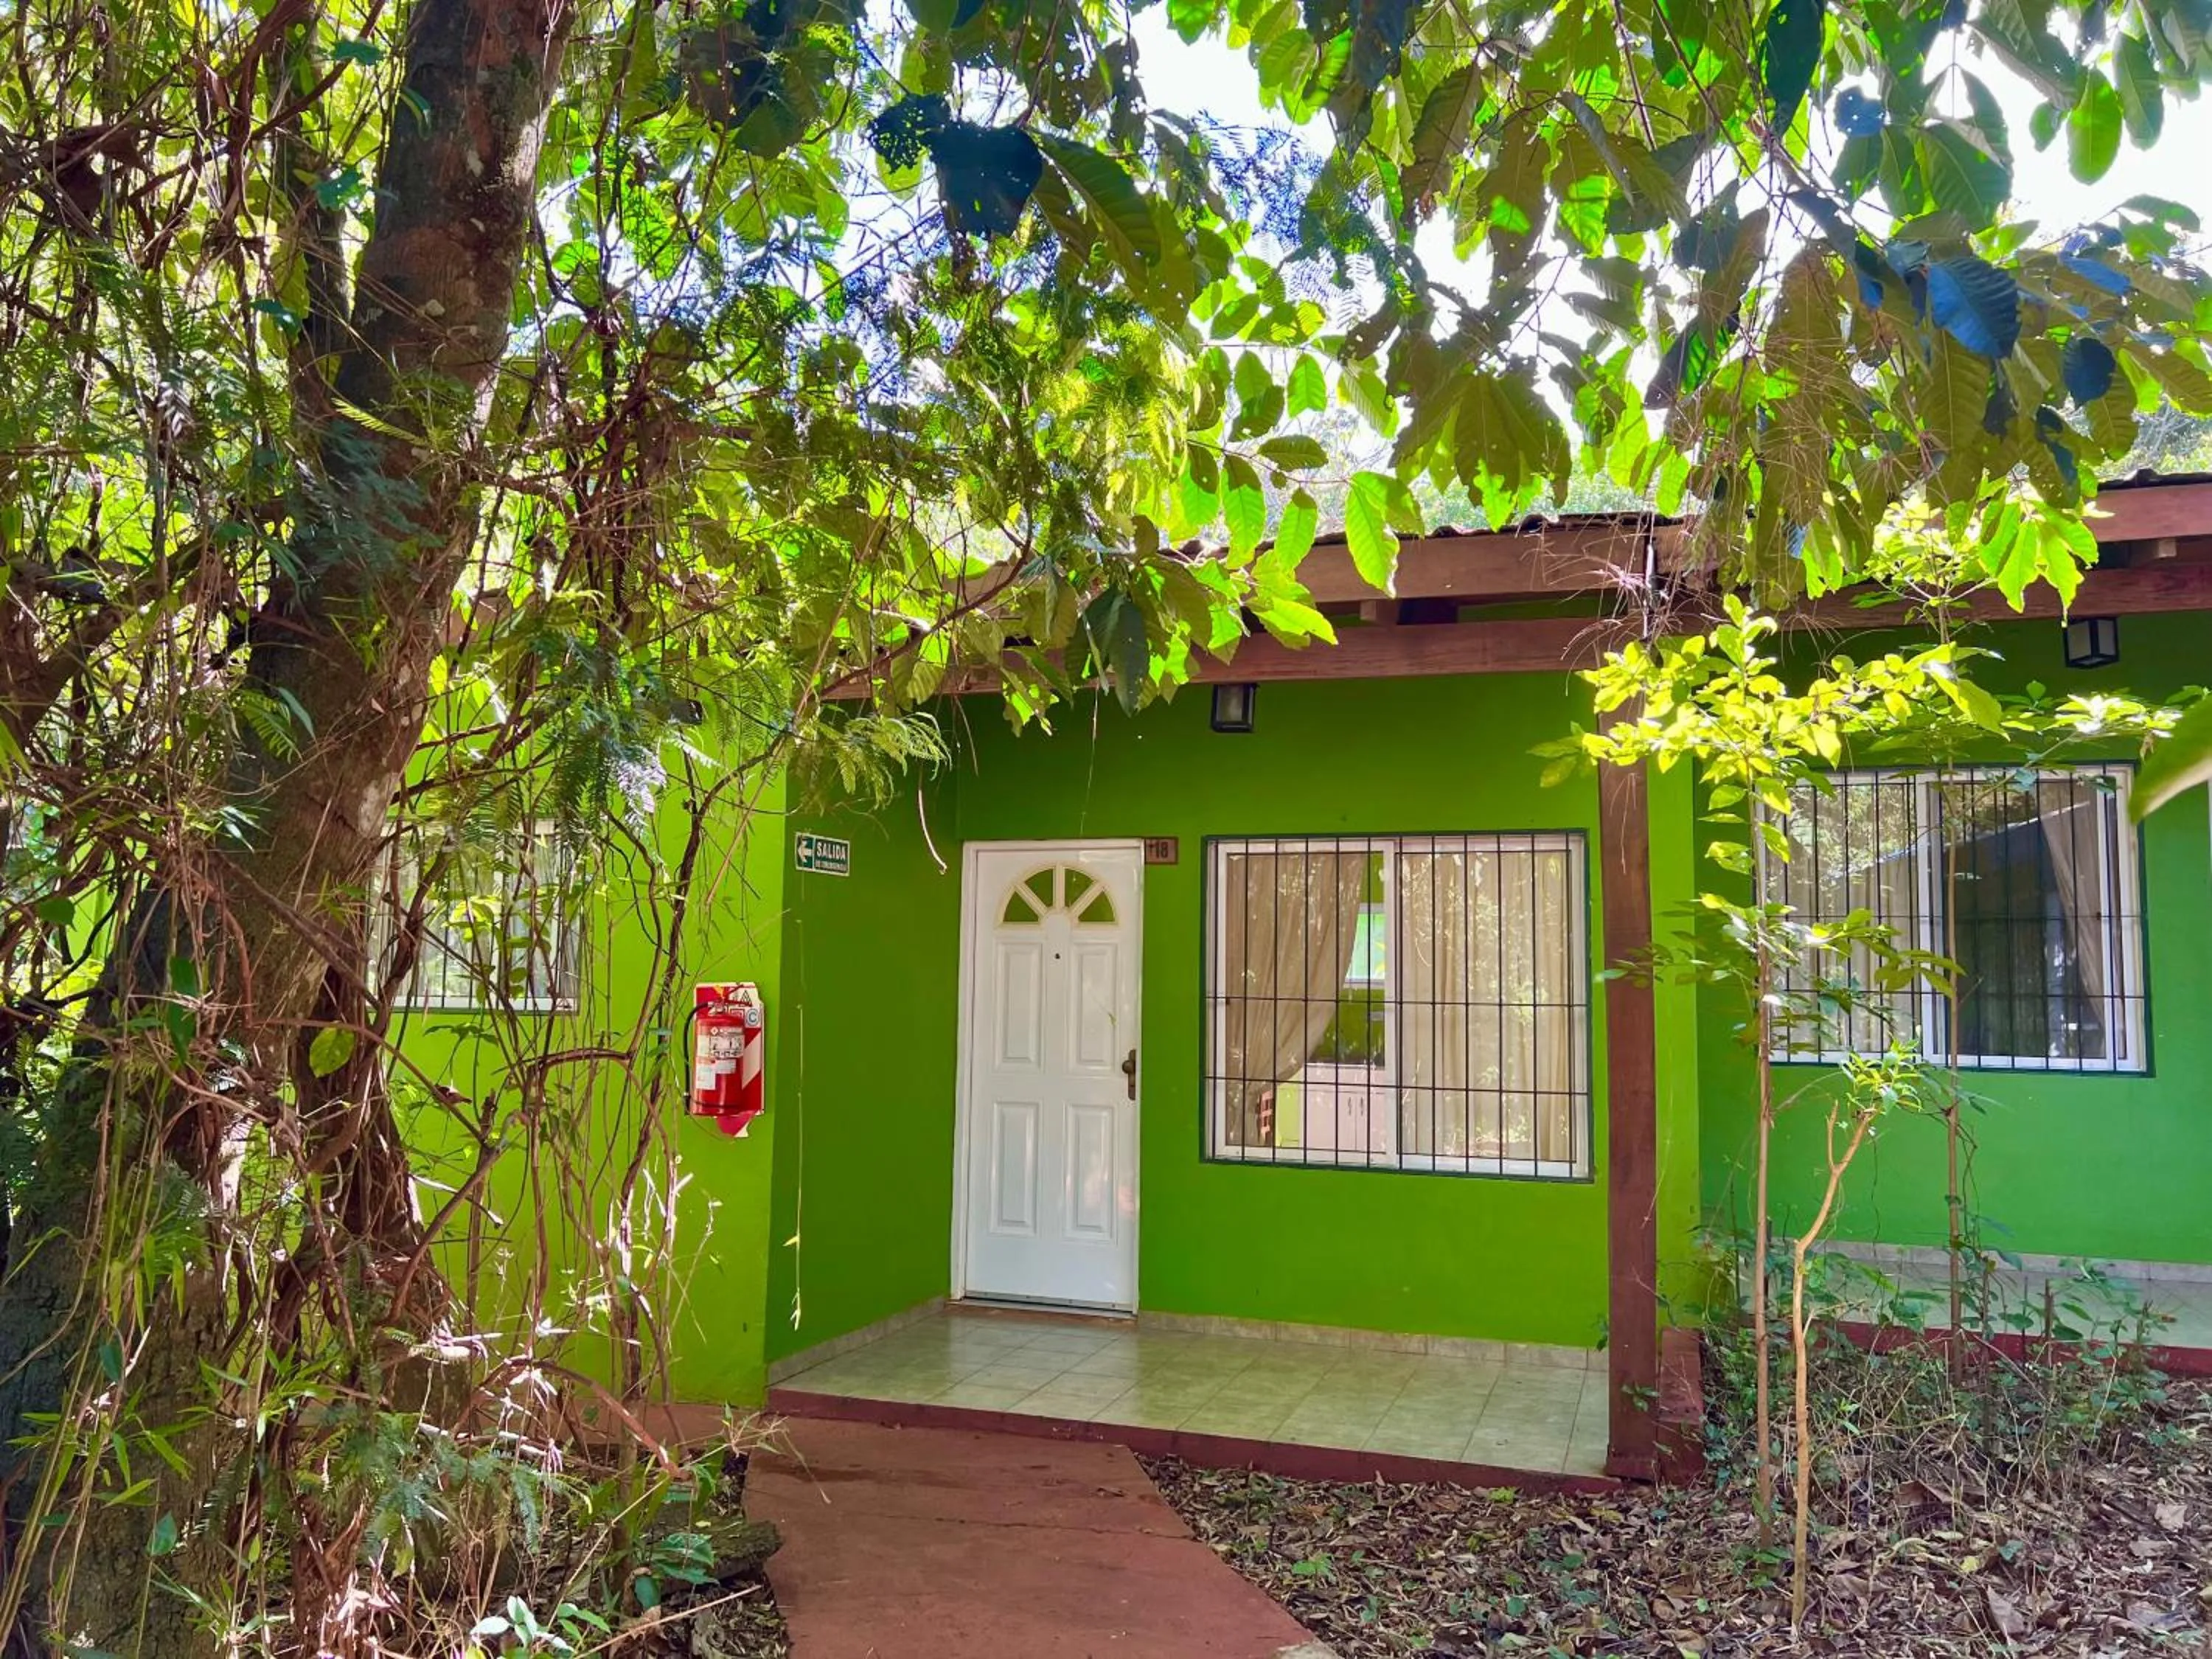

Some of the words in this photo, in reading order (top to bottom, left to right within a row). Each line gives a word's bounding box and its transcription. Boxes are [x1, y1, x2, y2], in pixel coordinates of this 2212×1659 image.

[816, 841, 846, 860] SALIDA
[1155, 841, 1169, 858] 18
[748, 1012, 757, 1023] C
